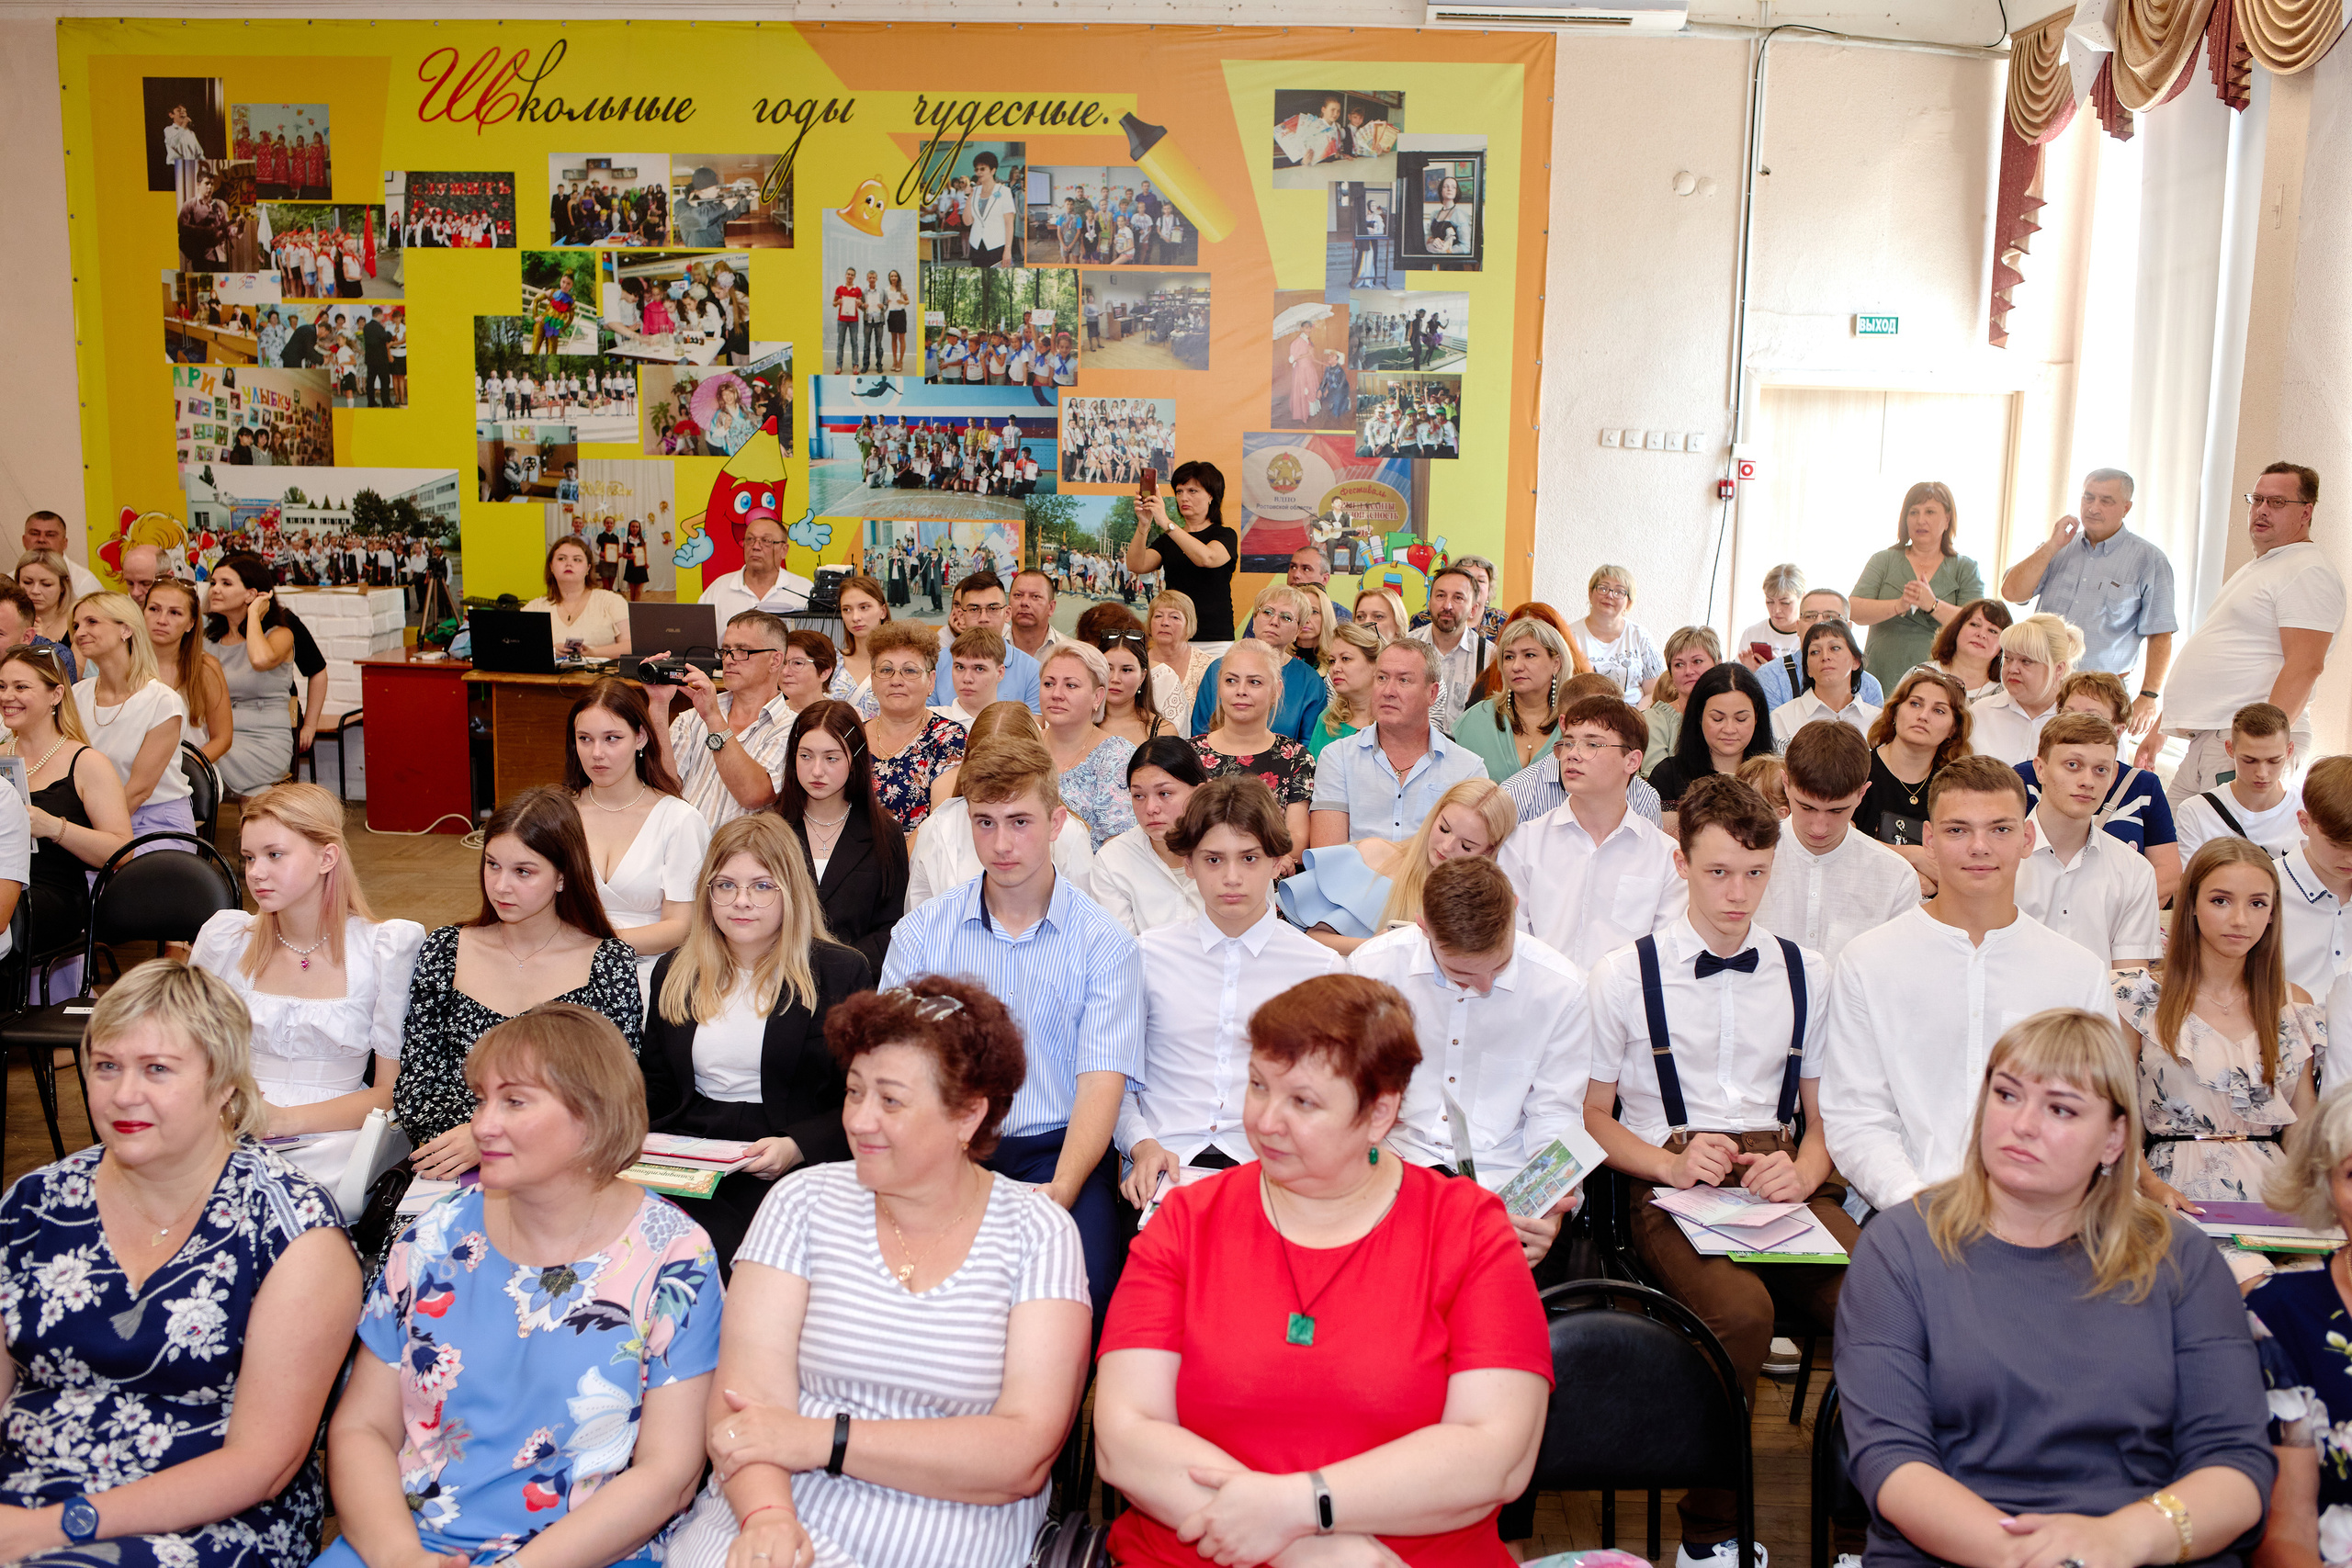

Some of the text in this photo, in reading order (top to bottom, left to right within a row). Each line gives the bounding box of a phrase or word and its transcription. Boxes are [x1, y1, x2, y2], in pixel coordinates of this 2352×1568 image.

[418, 39, 1111, 207] Школьные годы чудесные.
[413, 181, 512, 197] СЛУЖИТЬ
[1859, 318, 1897, 333] ВЫХОД
[242, 386, 291, 412] УЛЫБКУ
[1340, 484, 1386, 498] Фестиваль
